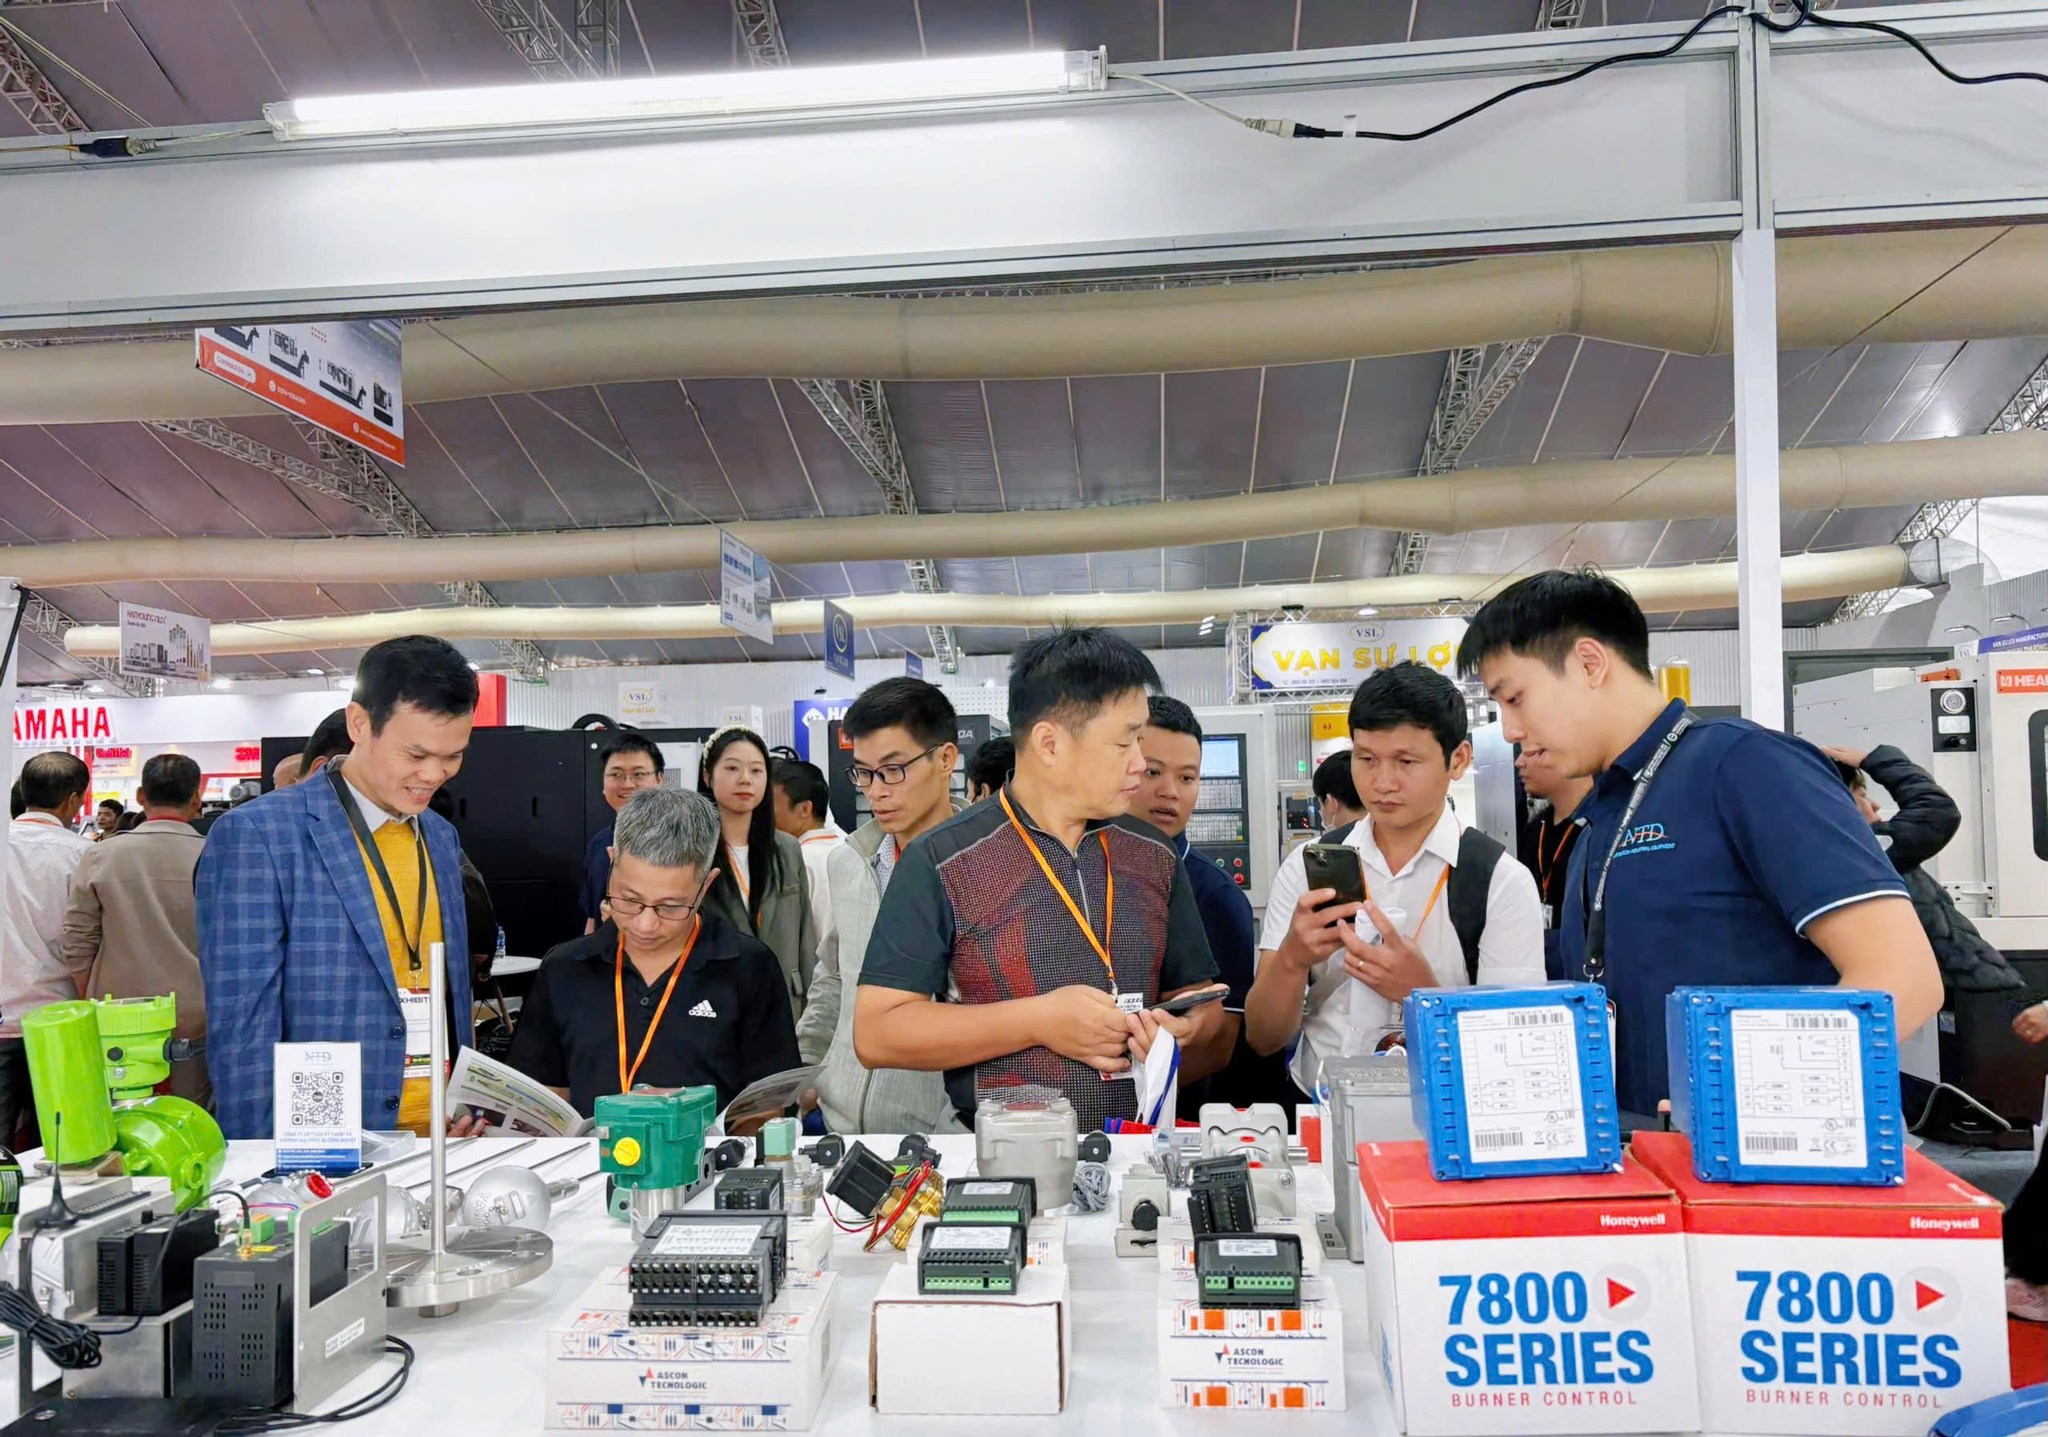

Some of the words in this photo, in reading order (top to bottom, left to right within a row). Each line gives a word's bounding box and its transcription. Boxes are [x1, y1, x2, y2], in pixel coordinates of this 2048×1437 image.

[1355, 628, 1380, 638] VSL
[1272, 648, 1341, 677] VẠN
[1600, 1213, 1666, 1230] Honeywell
[1910, 1216, 1980, 1232] Honeywell
[1439, 1271, 1588, 1326] 7800
[1736, 1270, 1894, 1326] 7800
[1234, 1348, 1264, 1356] ASCON
[1443, 1330, 1654, 1388] SERIES
[1740, 1330, 1963, 1389] SERIES
[1227, 1357, 1285, 1366] TECNOLOGIC
[657, 1371, 689, 1380] ASCON
[650, 1381, 707, 1390] TECNOLOGIC
[1451, 1392, 1532, 1409] BURNER
[1543, 1390, 1638, 1407] CONTROL
[1746, 1389, 1831, 1407] BURNER
[1842, 1391, 1943, 1410] CONTROL
